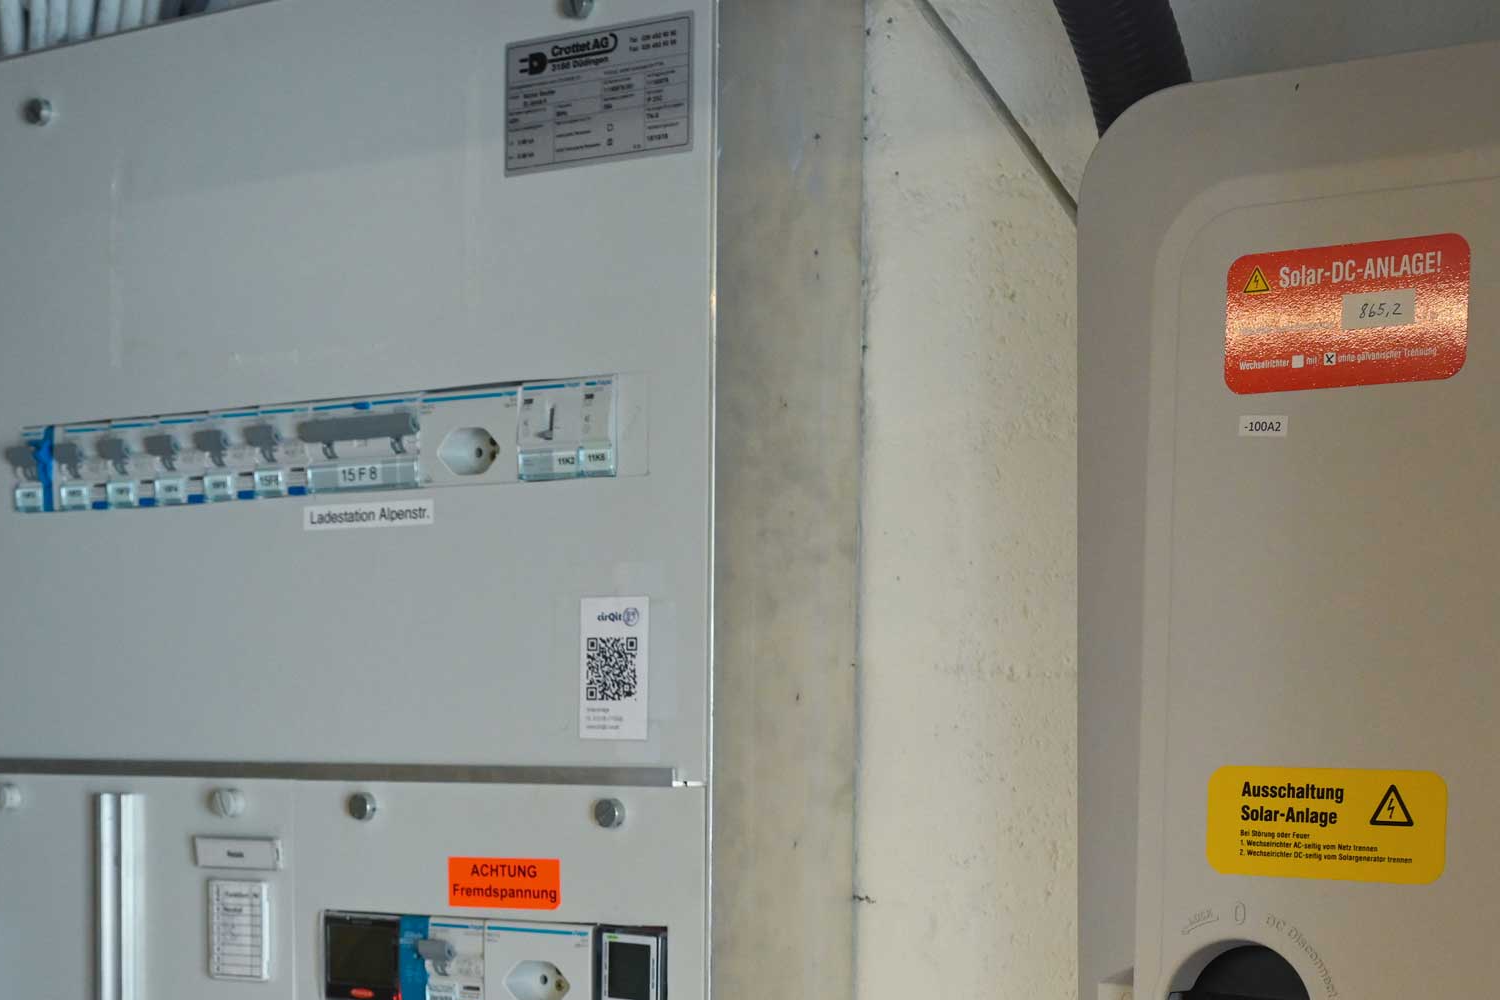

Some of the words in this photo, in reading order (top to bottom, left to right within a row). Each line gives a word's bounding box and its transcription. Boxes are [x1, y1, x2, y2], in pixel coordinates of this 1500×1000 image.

[551, 41, 590, 57] Crottet
[590, 36, 609, 50] AG
[1279, 251, 1442, 288] Solar-DC-ANLAGE!
[1244, 421, 1281, 432] -100A2
[341, 468, 356, 481] 15
[359, 468, 367, 480] F
[369, 467, 378, 480] 8
[310, 507, 375, 525] Ladestation
[379, 506, 430, 523] Alpenstr.
[597, 611, 622, 622] cirQit
[1241, 781, 1344, 804] Ausschaltung
[1241, 805, 1337, 827] Solar-Anlage
[1246, 840, 1292, 848] Wechselrichter
[1337, 843, 1352, 851] Netz
[1353, 844, 1378, 852] trennen
[1247, 849, 1292, 858] Wechselrichter
[1338, 853, 1386, 863] Solargenerator
[471, 864, 537, 879] ACHTUNG
[453, 883, 557, 904] Fremdspannung
